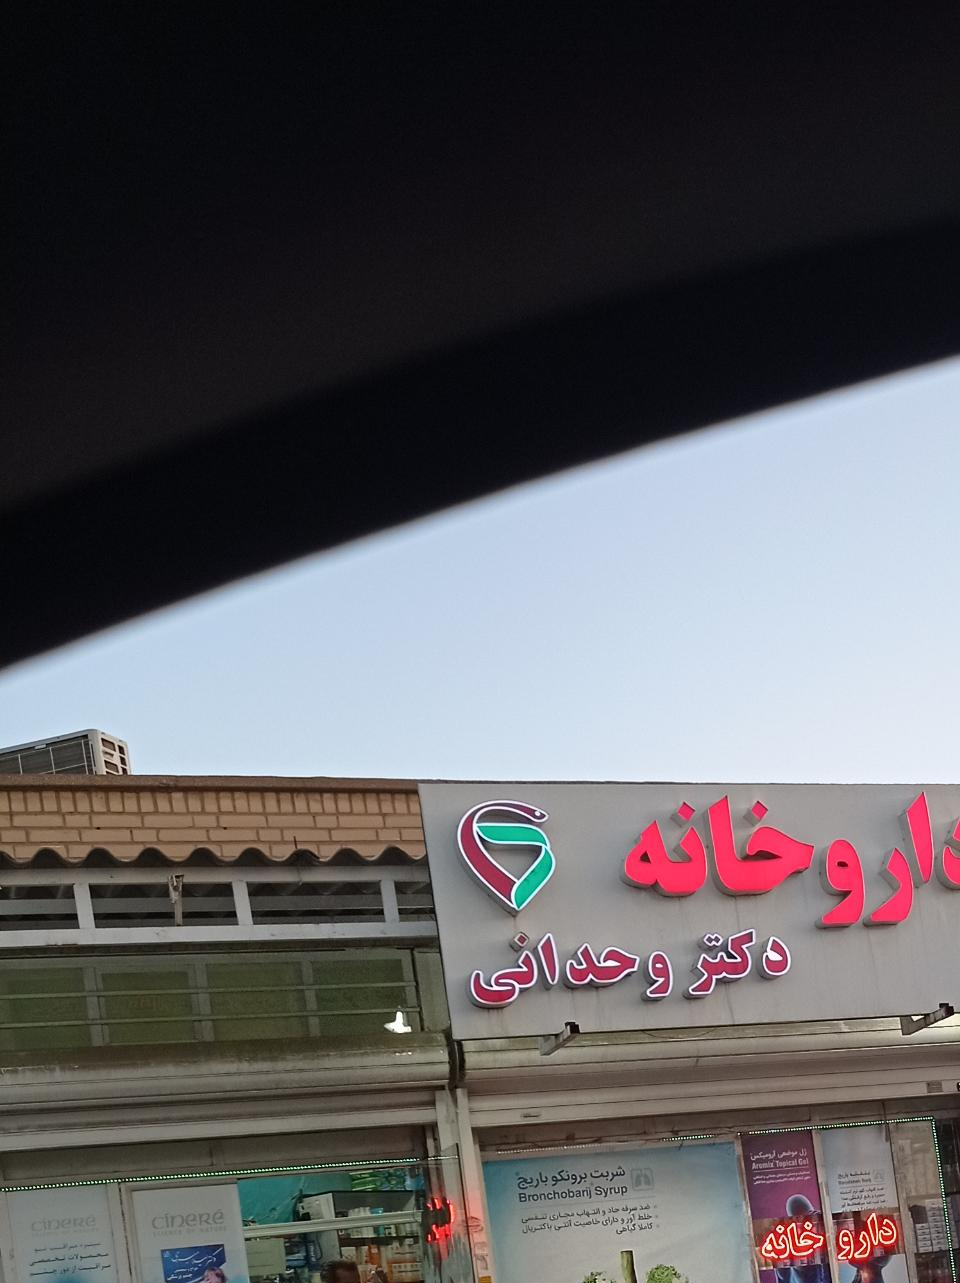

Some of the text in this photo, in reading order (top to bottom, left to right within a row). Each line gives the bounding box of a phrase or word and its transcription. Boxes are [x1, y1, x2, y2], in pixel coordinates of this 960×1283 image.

[683, 930, 792, 999] دکتر
[517, 1165, 626, 1190] شربت برونکو باریج
[519, 1184, 628, 1203] Bronchobarij Syrup
[621, 1205, 638, 1214] سرفه
[601, 1216, 619, 1226] دارای
[616, 1222, 653, 1235] کاملا گیاهی
[761, 1212, 897, 1260] دارو خانه
